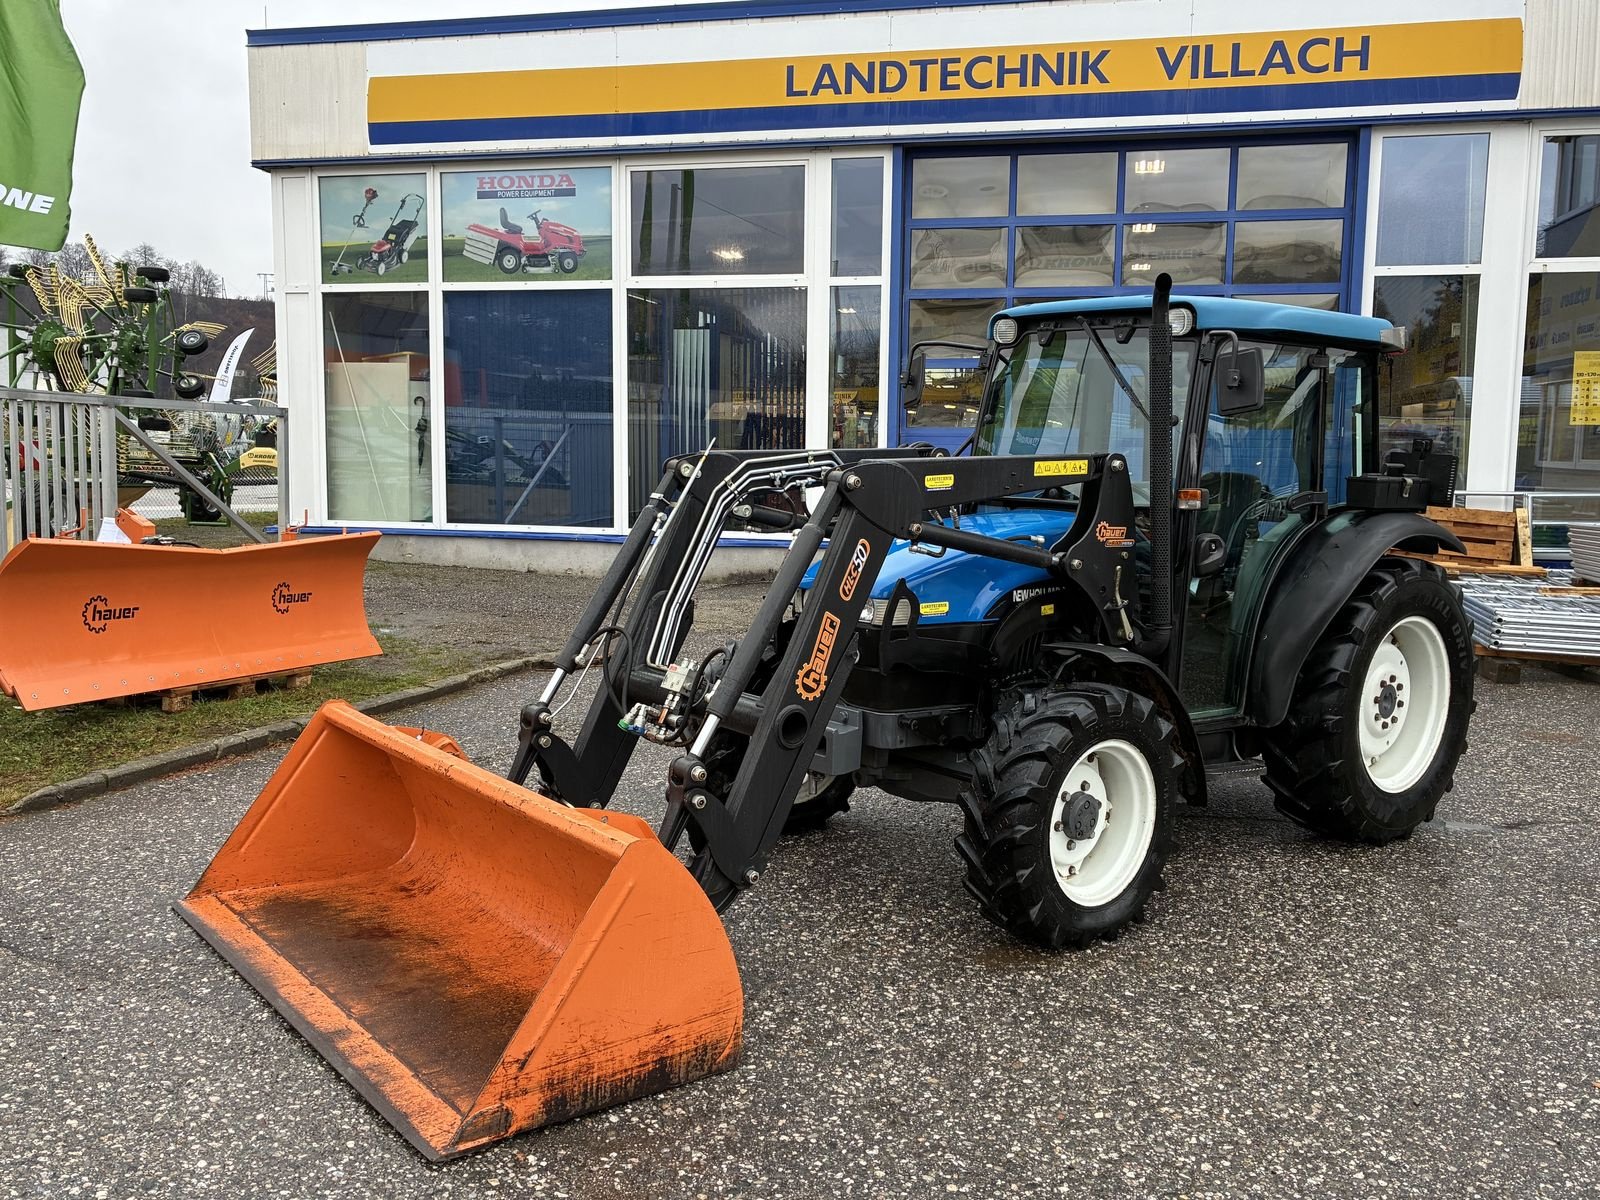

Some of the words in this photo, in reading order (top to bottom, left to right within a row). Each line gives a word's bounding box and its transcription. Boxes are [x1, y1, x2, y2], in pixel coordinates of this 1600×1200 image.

[786, 49, 1112, 98] LANDTECHNIK
[1155, 34, 1371, 80] VILLACH
[476, 174, 576, 189] HONDA
[0, 184, 55, 214] NE
[497, 190, 520, 198] POWER
[520, 189, 555, 197] EQUIPMENT
[1100, 526, 1125, 537] hauer
[277, 590, 313, 604] hauer
[1012, 588, 1029, 603] NEW
[91, 604, 140, 622] hauer
[802, 617, 836, 690] hauer
